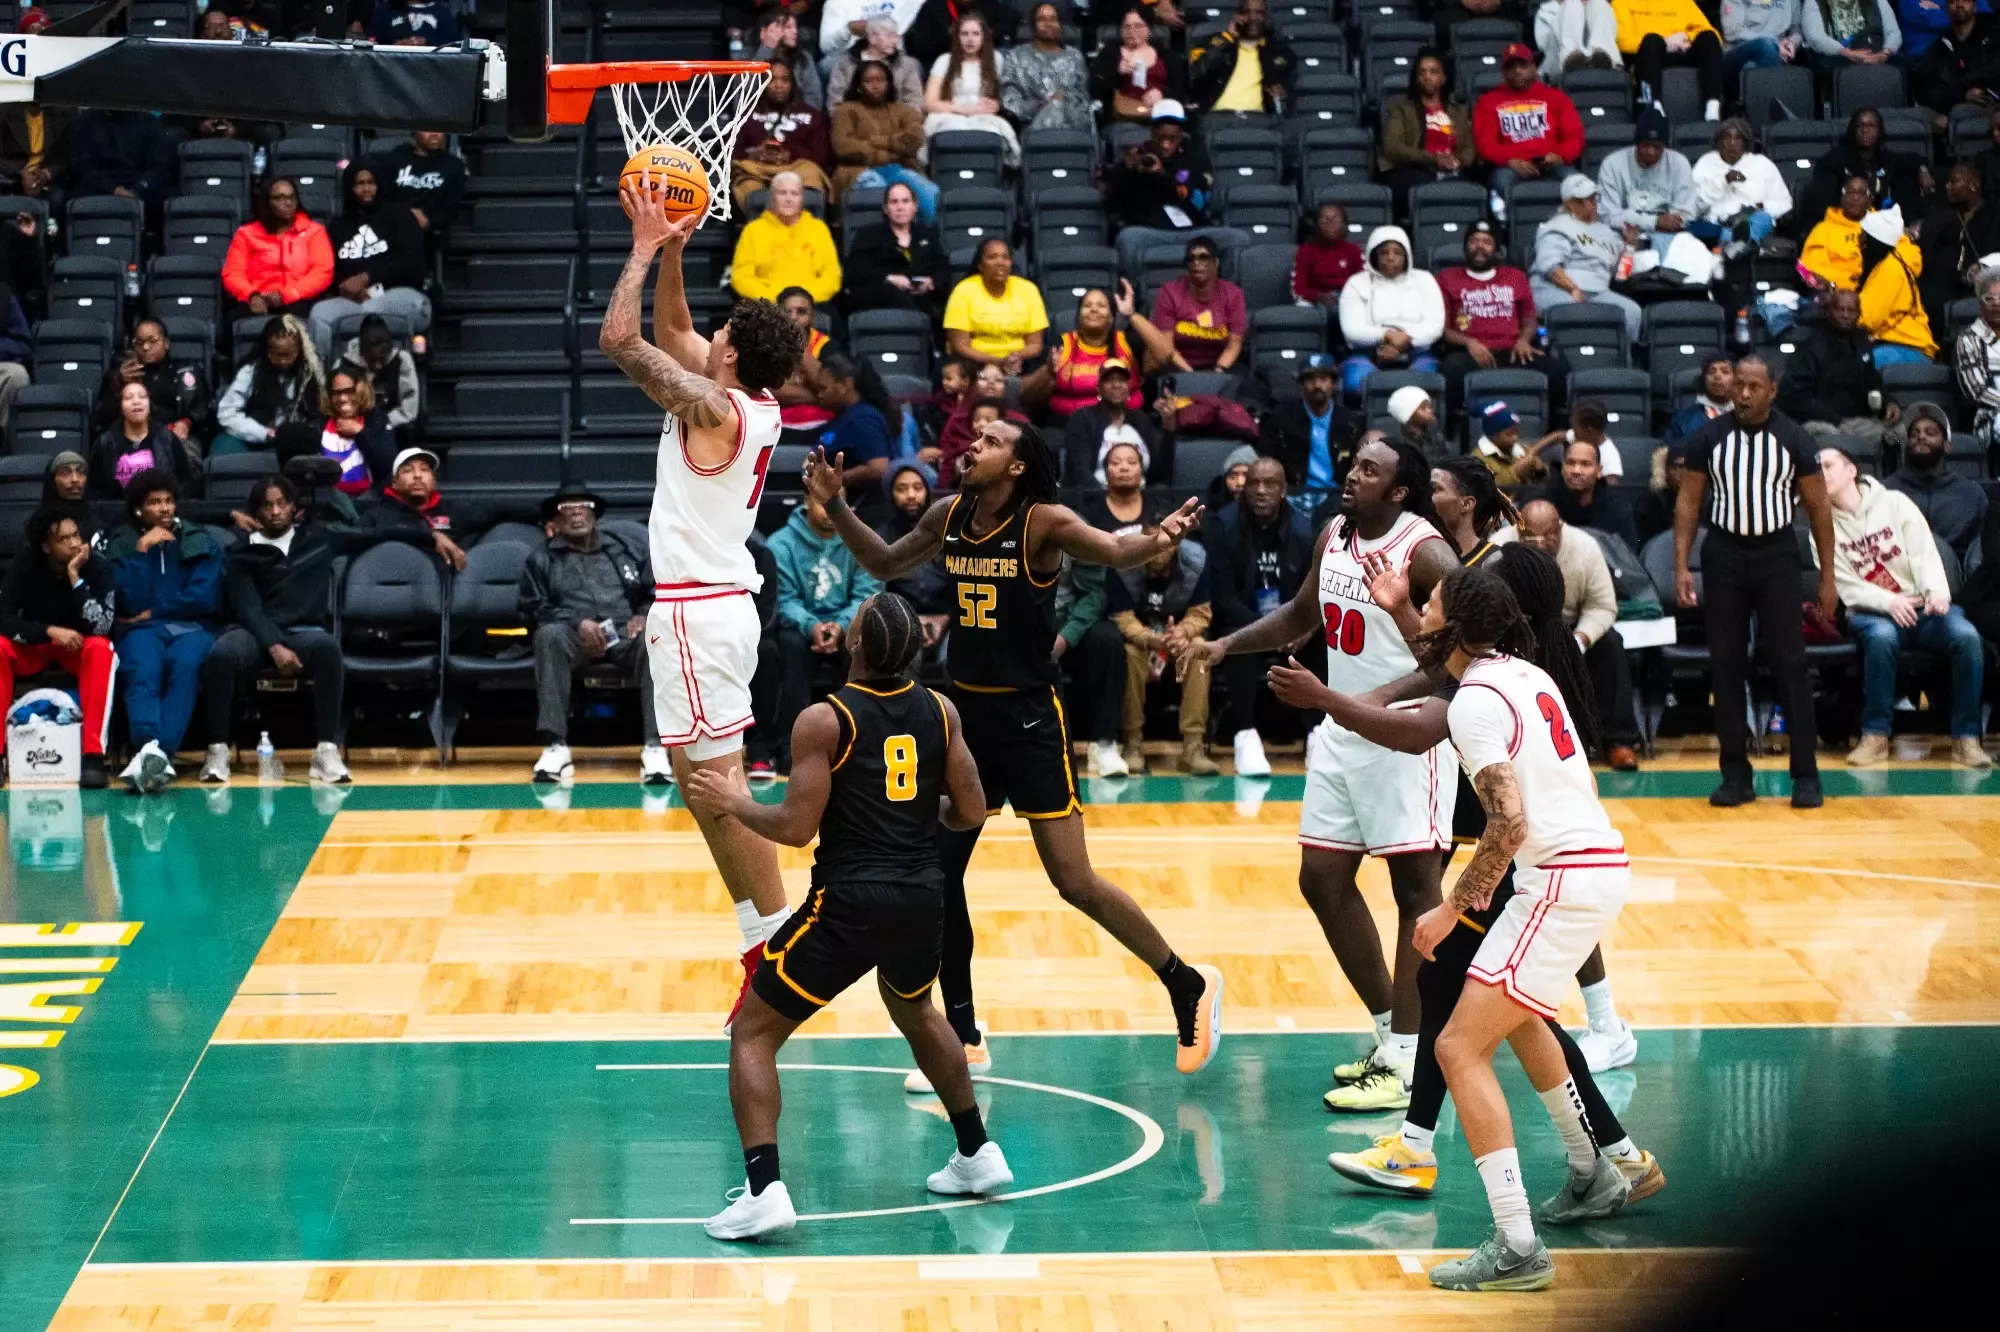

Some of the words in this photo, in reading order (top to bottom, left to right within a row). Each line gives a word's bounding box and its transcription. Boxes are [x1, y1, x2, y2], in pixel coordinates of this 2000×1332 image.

[1501, 113, 1547, 133] BLACK
[651, 156, 692, 173] NCAA
[639, 178, 694, 204] Wilo
[746, 444, 774, 509] 1
[945, 554, 1018, 577] MARAUDERS
[1320, 567, 1376, 606] TITAN
[957, 582, 997, 629] 52
[1323, 602, 1365, 656] 20
[1536, 692, 1576, 761] 2
[884, 734, 918, 801] 8
